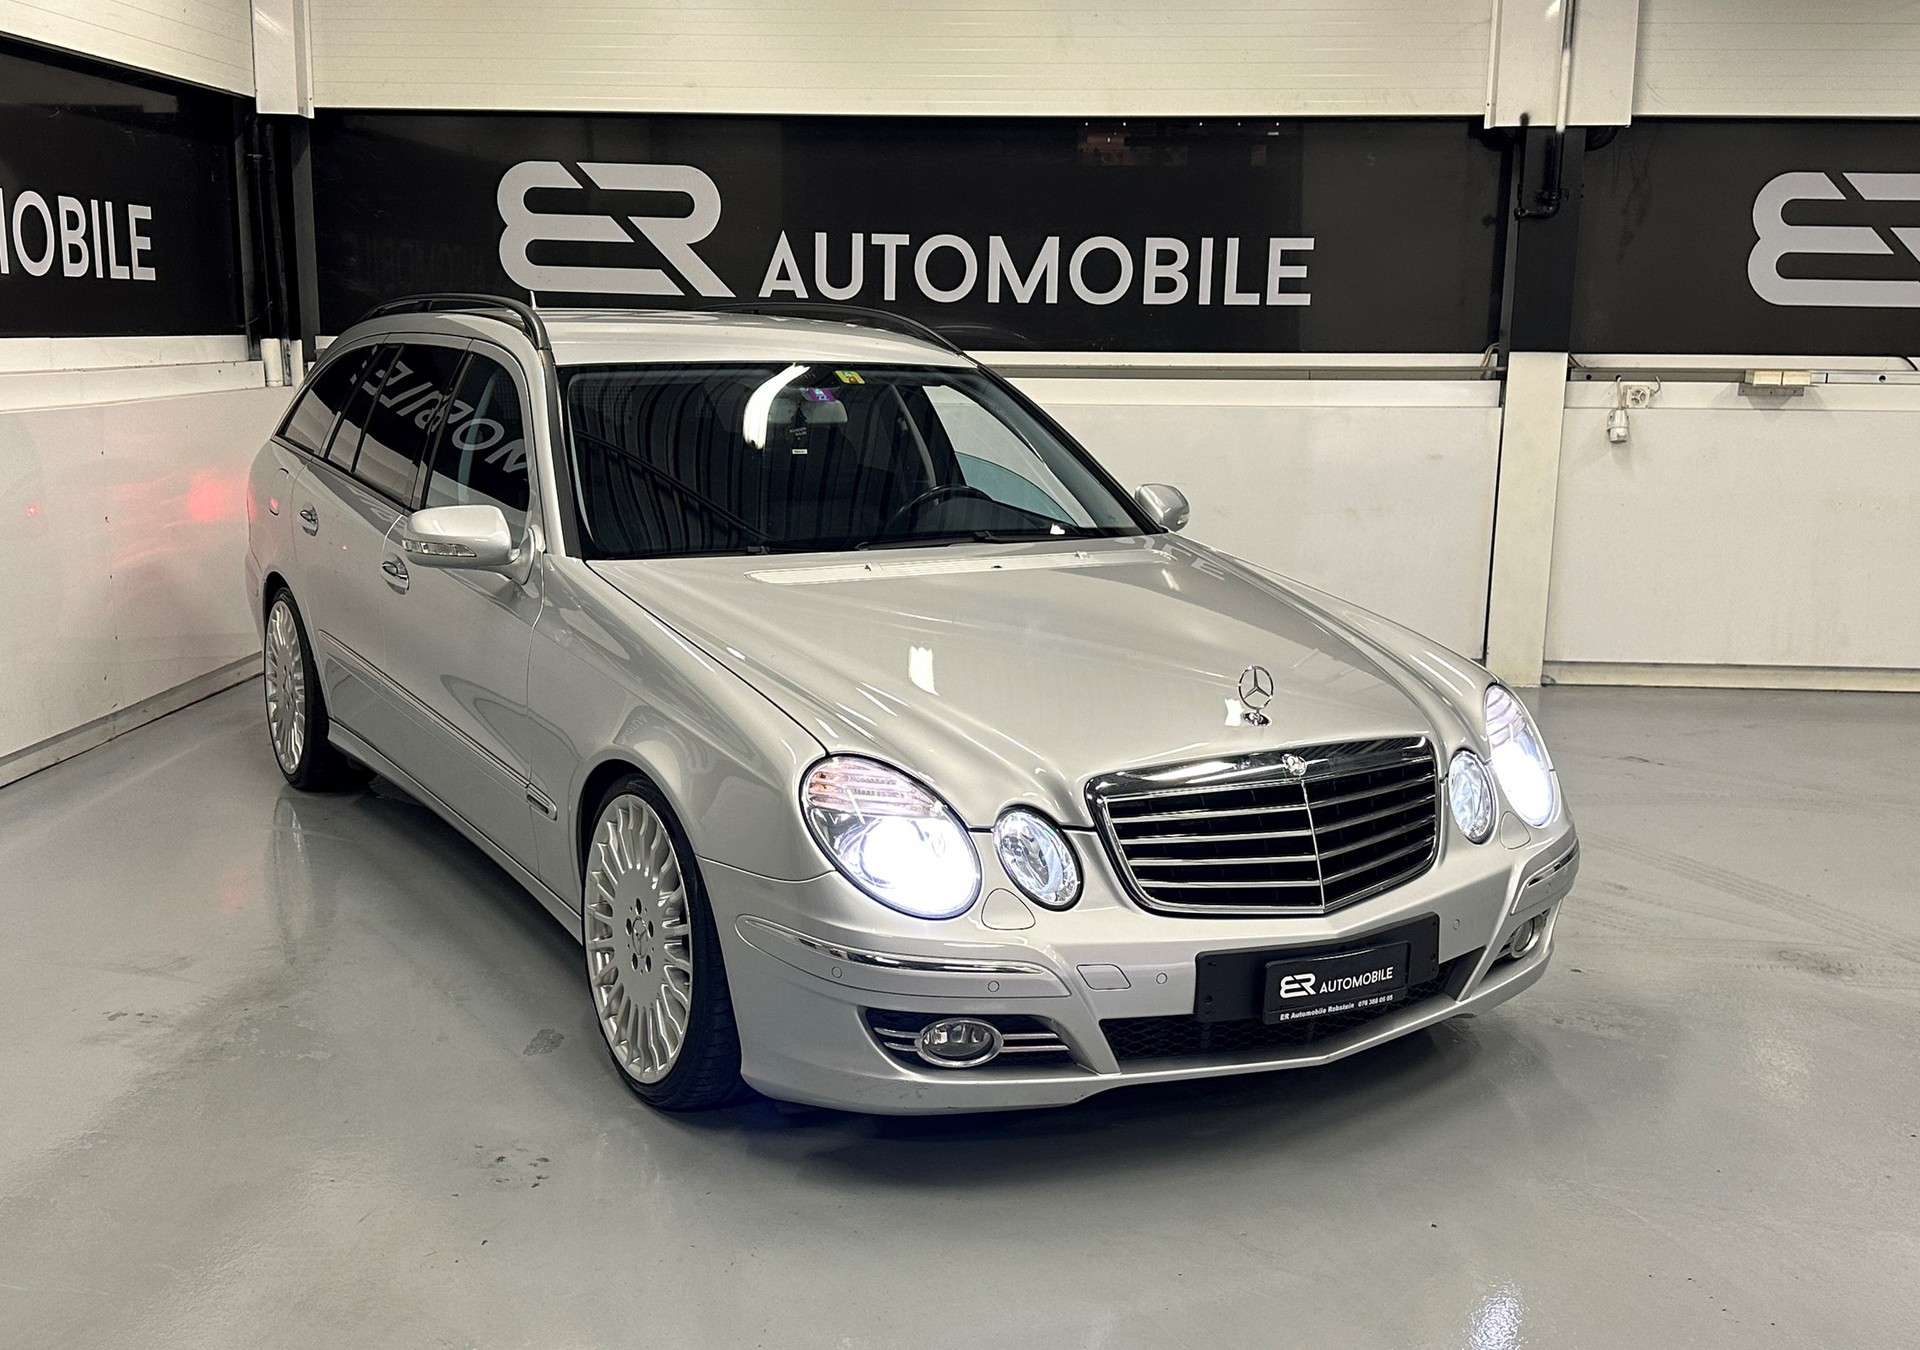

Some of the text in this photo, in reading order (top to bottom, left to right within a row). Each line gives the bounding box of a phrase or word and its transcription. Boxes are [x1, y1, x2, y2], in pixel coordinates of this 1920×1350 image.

[758, 231, 1315, 306] AUTOMOBILE
[1319, 966, 1393, 993] AUTOMOBILE
[1280, 1013, 1290, 1021] ER
[1290, 1007, 1326, 1019] Automobile
